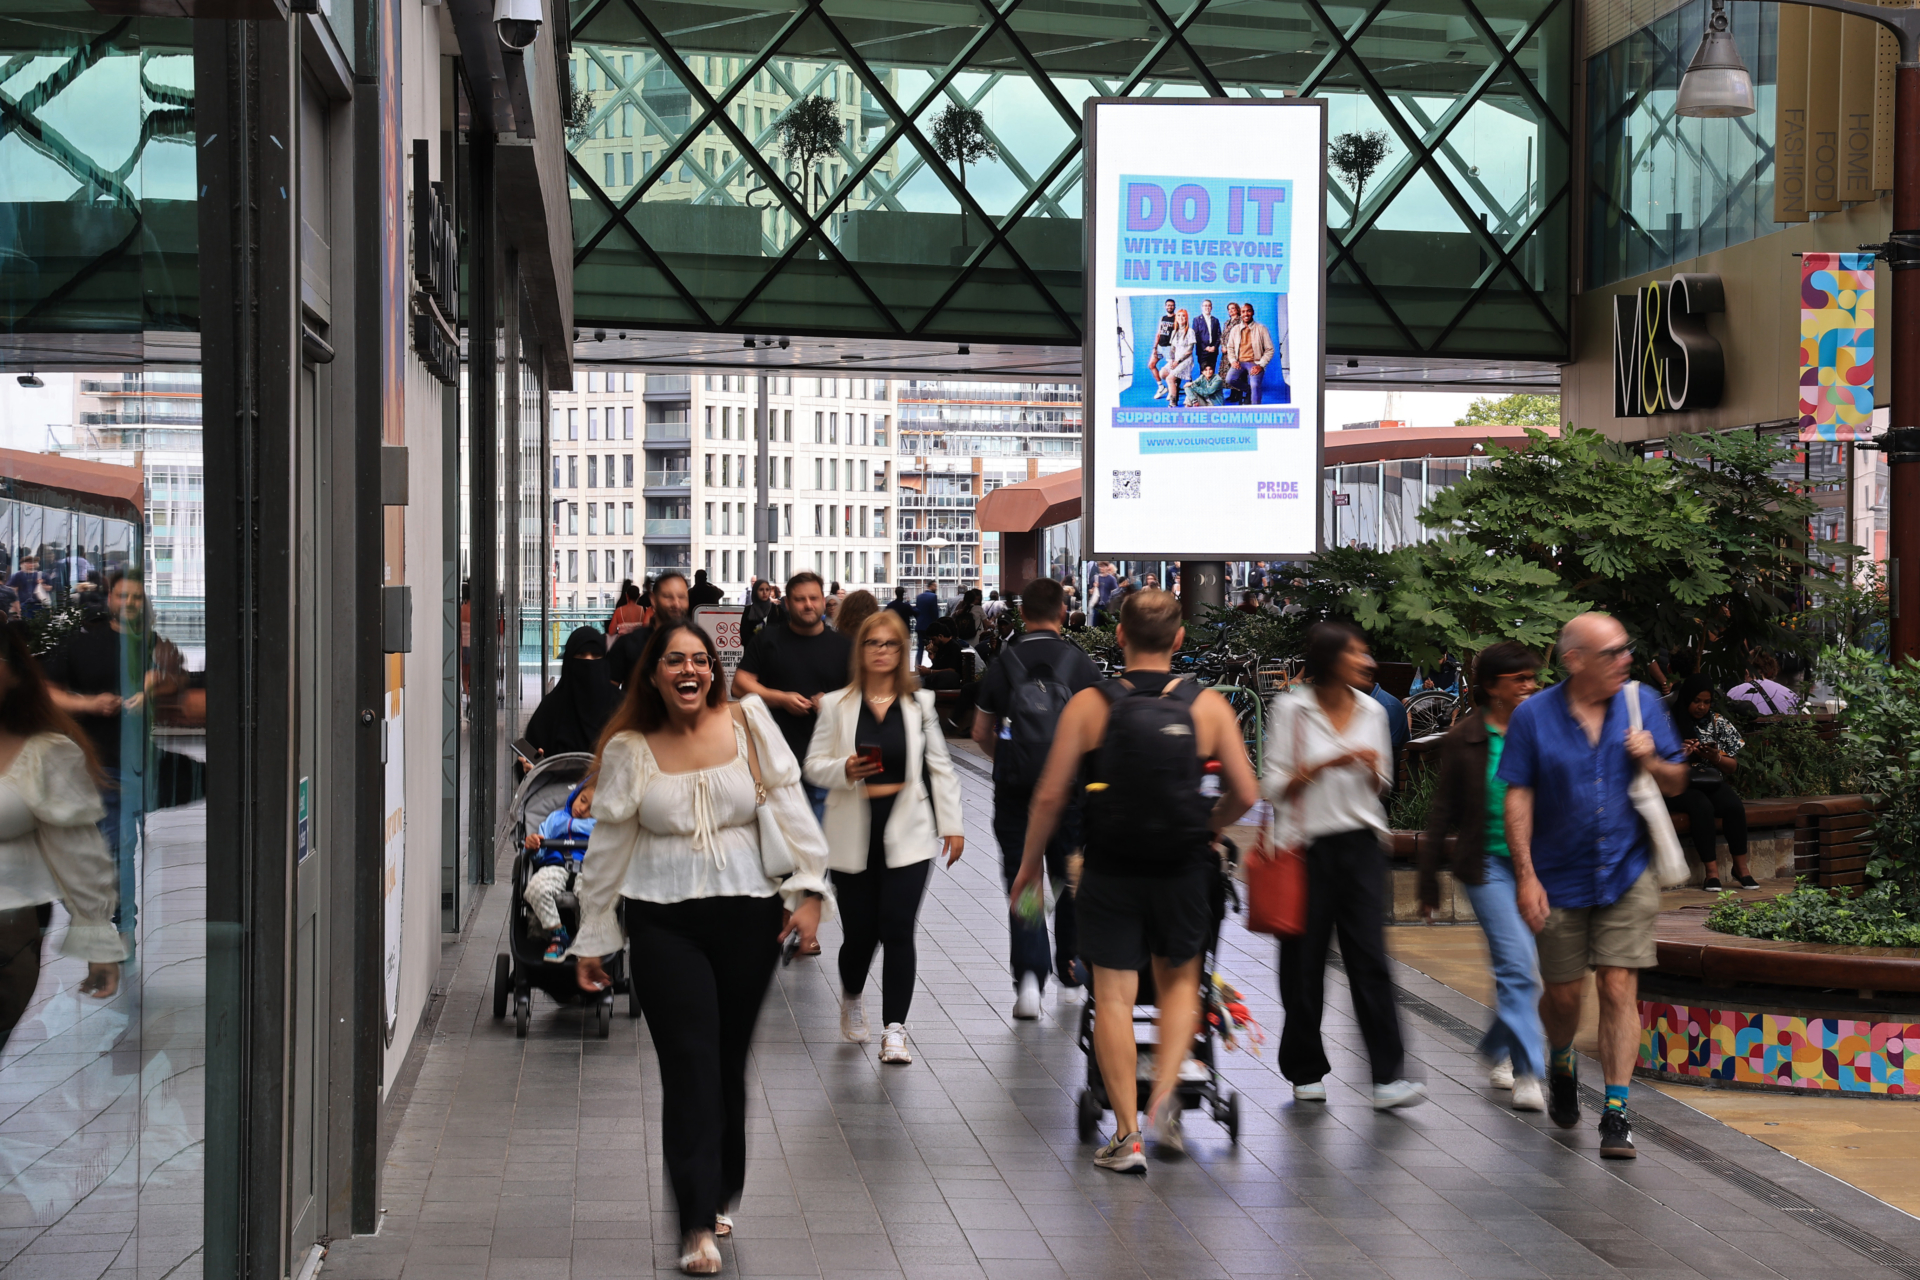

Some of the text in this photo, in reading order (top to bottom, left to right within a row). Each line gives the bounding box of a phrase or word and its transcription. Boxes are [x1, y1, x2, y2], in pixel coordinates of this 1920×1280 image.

[1783, 109, 1805, 212] FASHION
[1815, 131, 1836, 201] FOOD
[1847, 113, 1870, 191] HOME
[1126, 182, 1286, 236] DO IT
[1124, 237, 1284, 258] WITH EVERYONE
[1124, 259, 1284, 285] IN THIS CITY
[1613, 272, 1692, 419] M&S
[1116, 411, 1296, 424] SUPPORT THE COMMUNITY
[1146, 436, 1251, 447] WWW.VOLUNQUEER.UK
[1257, 492, 1299, 500] IN LONDON
